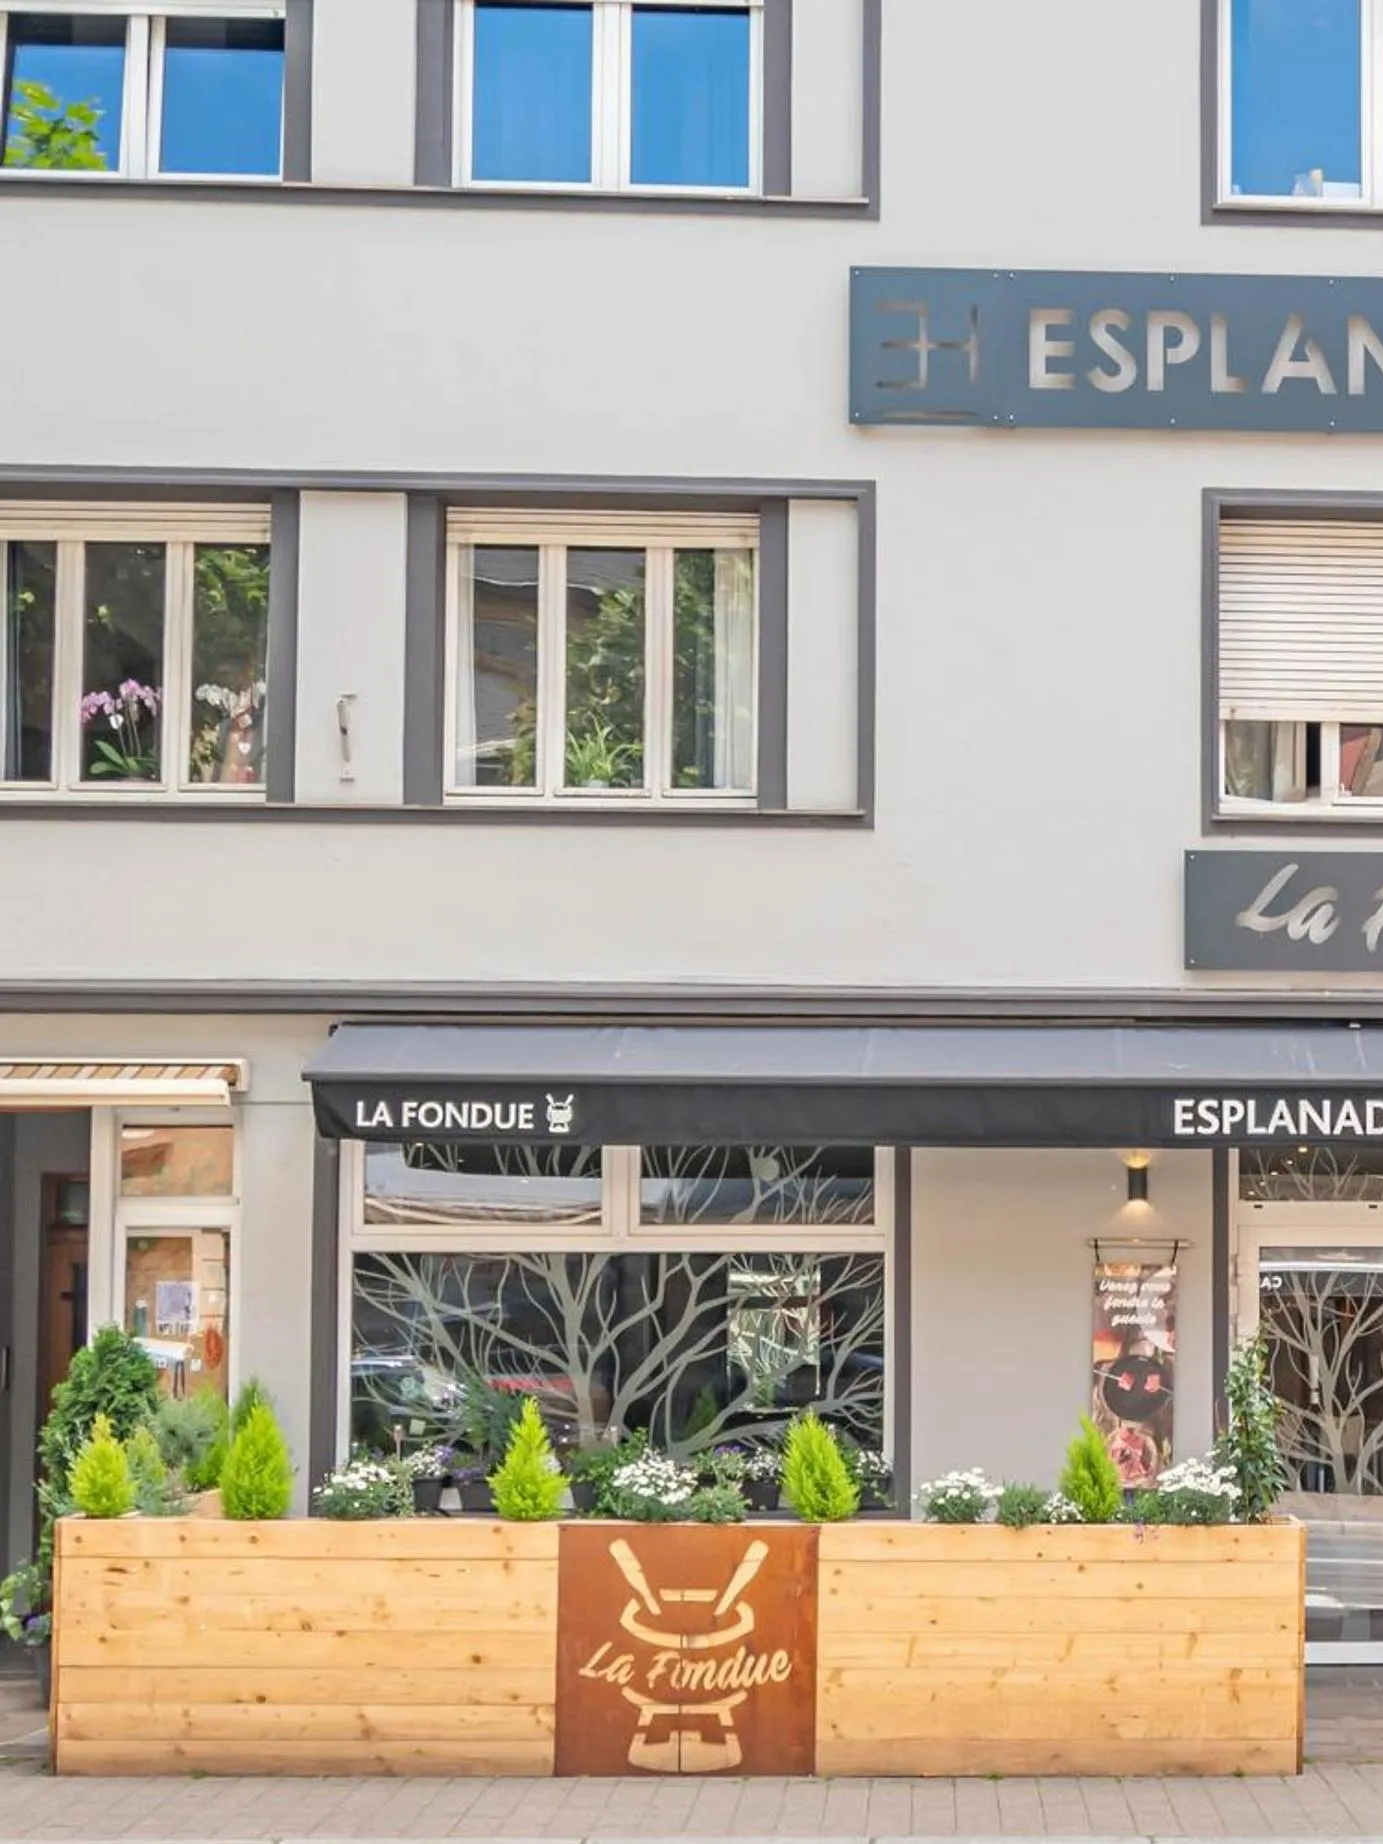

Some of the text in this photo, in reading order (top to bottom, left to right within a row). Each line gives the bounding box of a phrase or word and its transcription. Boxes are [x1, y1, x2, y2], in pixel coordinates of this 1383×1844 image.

[1236, 863, 1339, 943] La
[356, 1100, 534, 1129] LA FONDUE
[578, 1641, 792, 1691] La Fondue
